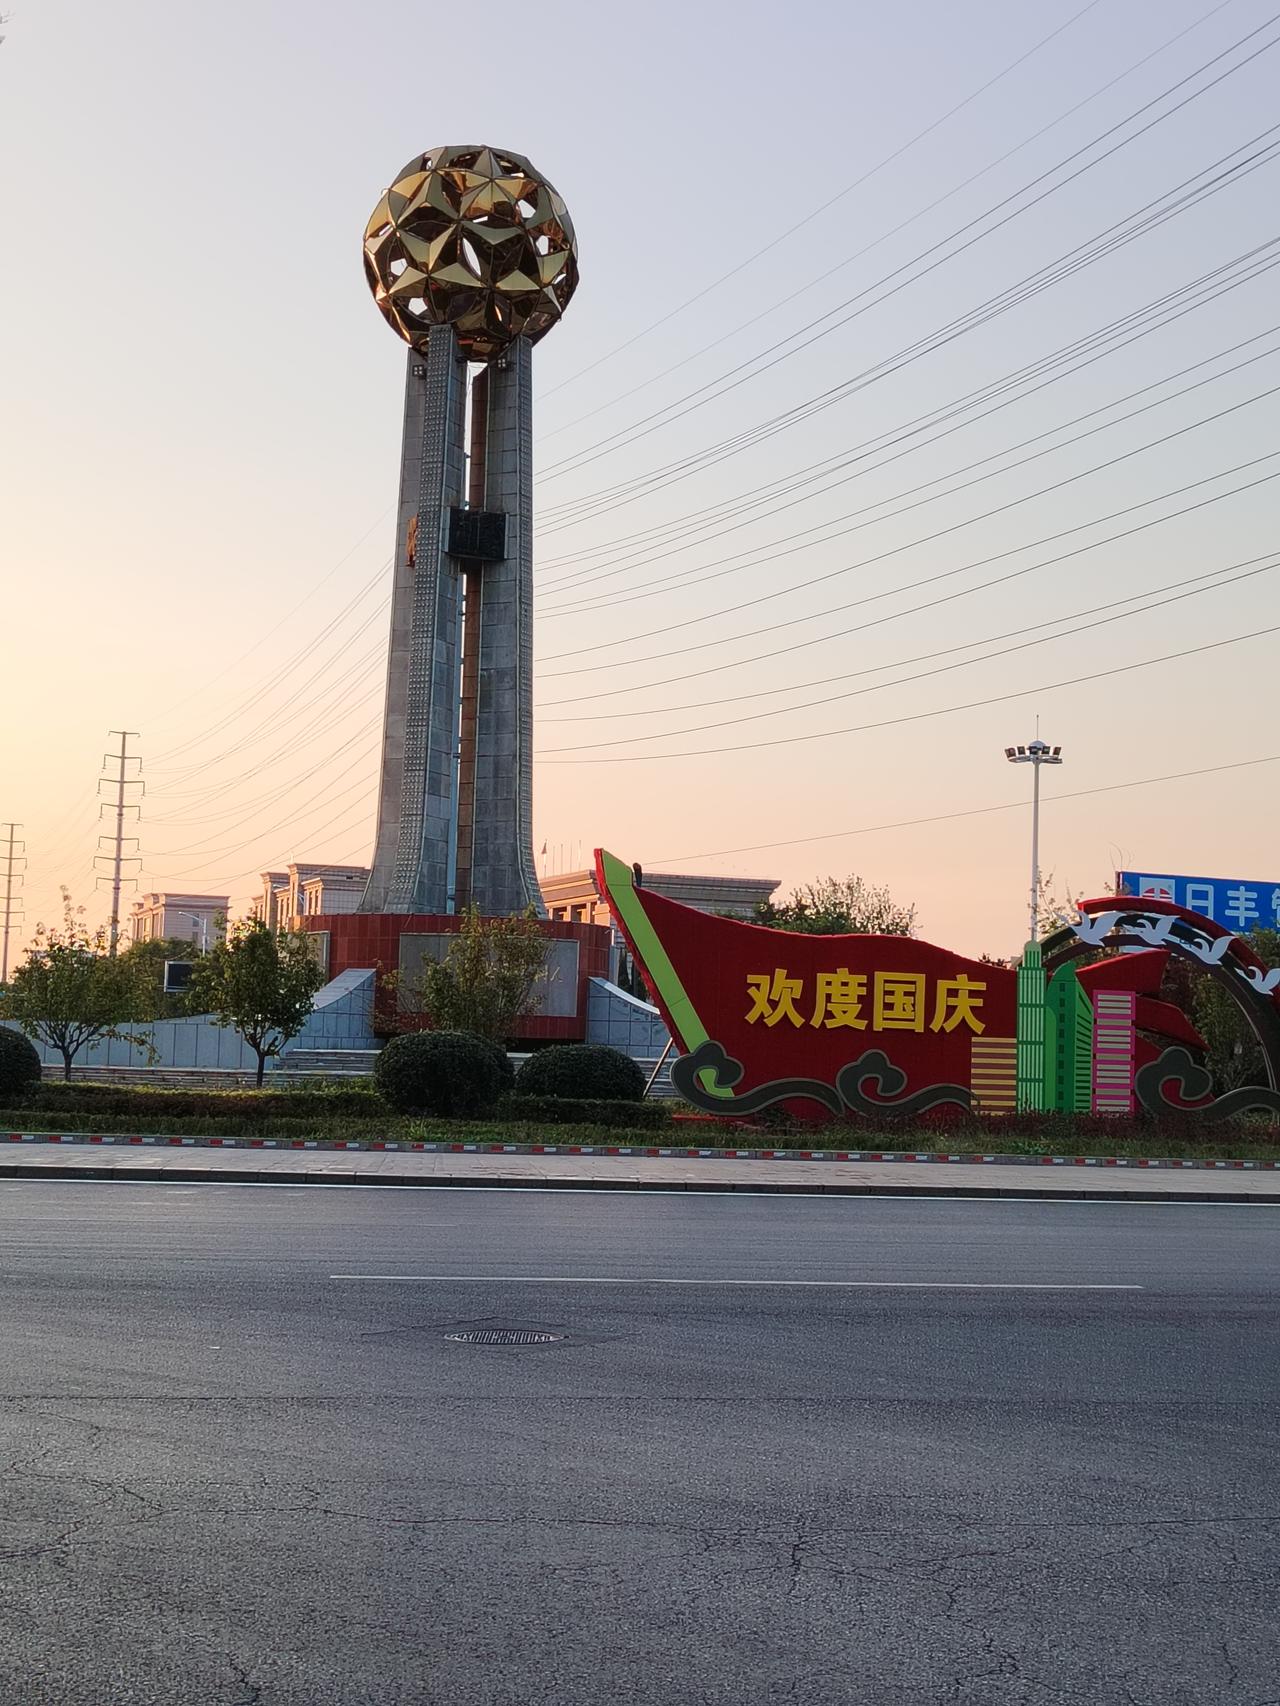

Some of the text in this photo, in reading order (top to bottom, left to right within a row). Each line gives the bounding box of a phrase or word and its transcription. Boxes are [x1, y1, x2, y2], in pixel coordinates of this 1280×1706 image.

[1186, 883, 1280, 927] 日丰
[745, 968, 987, 1034] 欢度国庆
